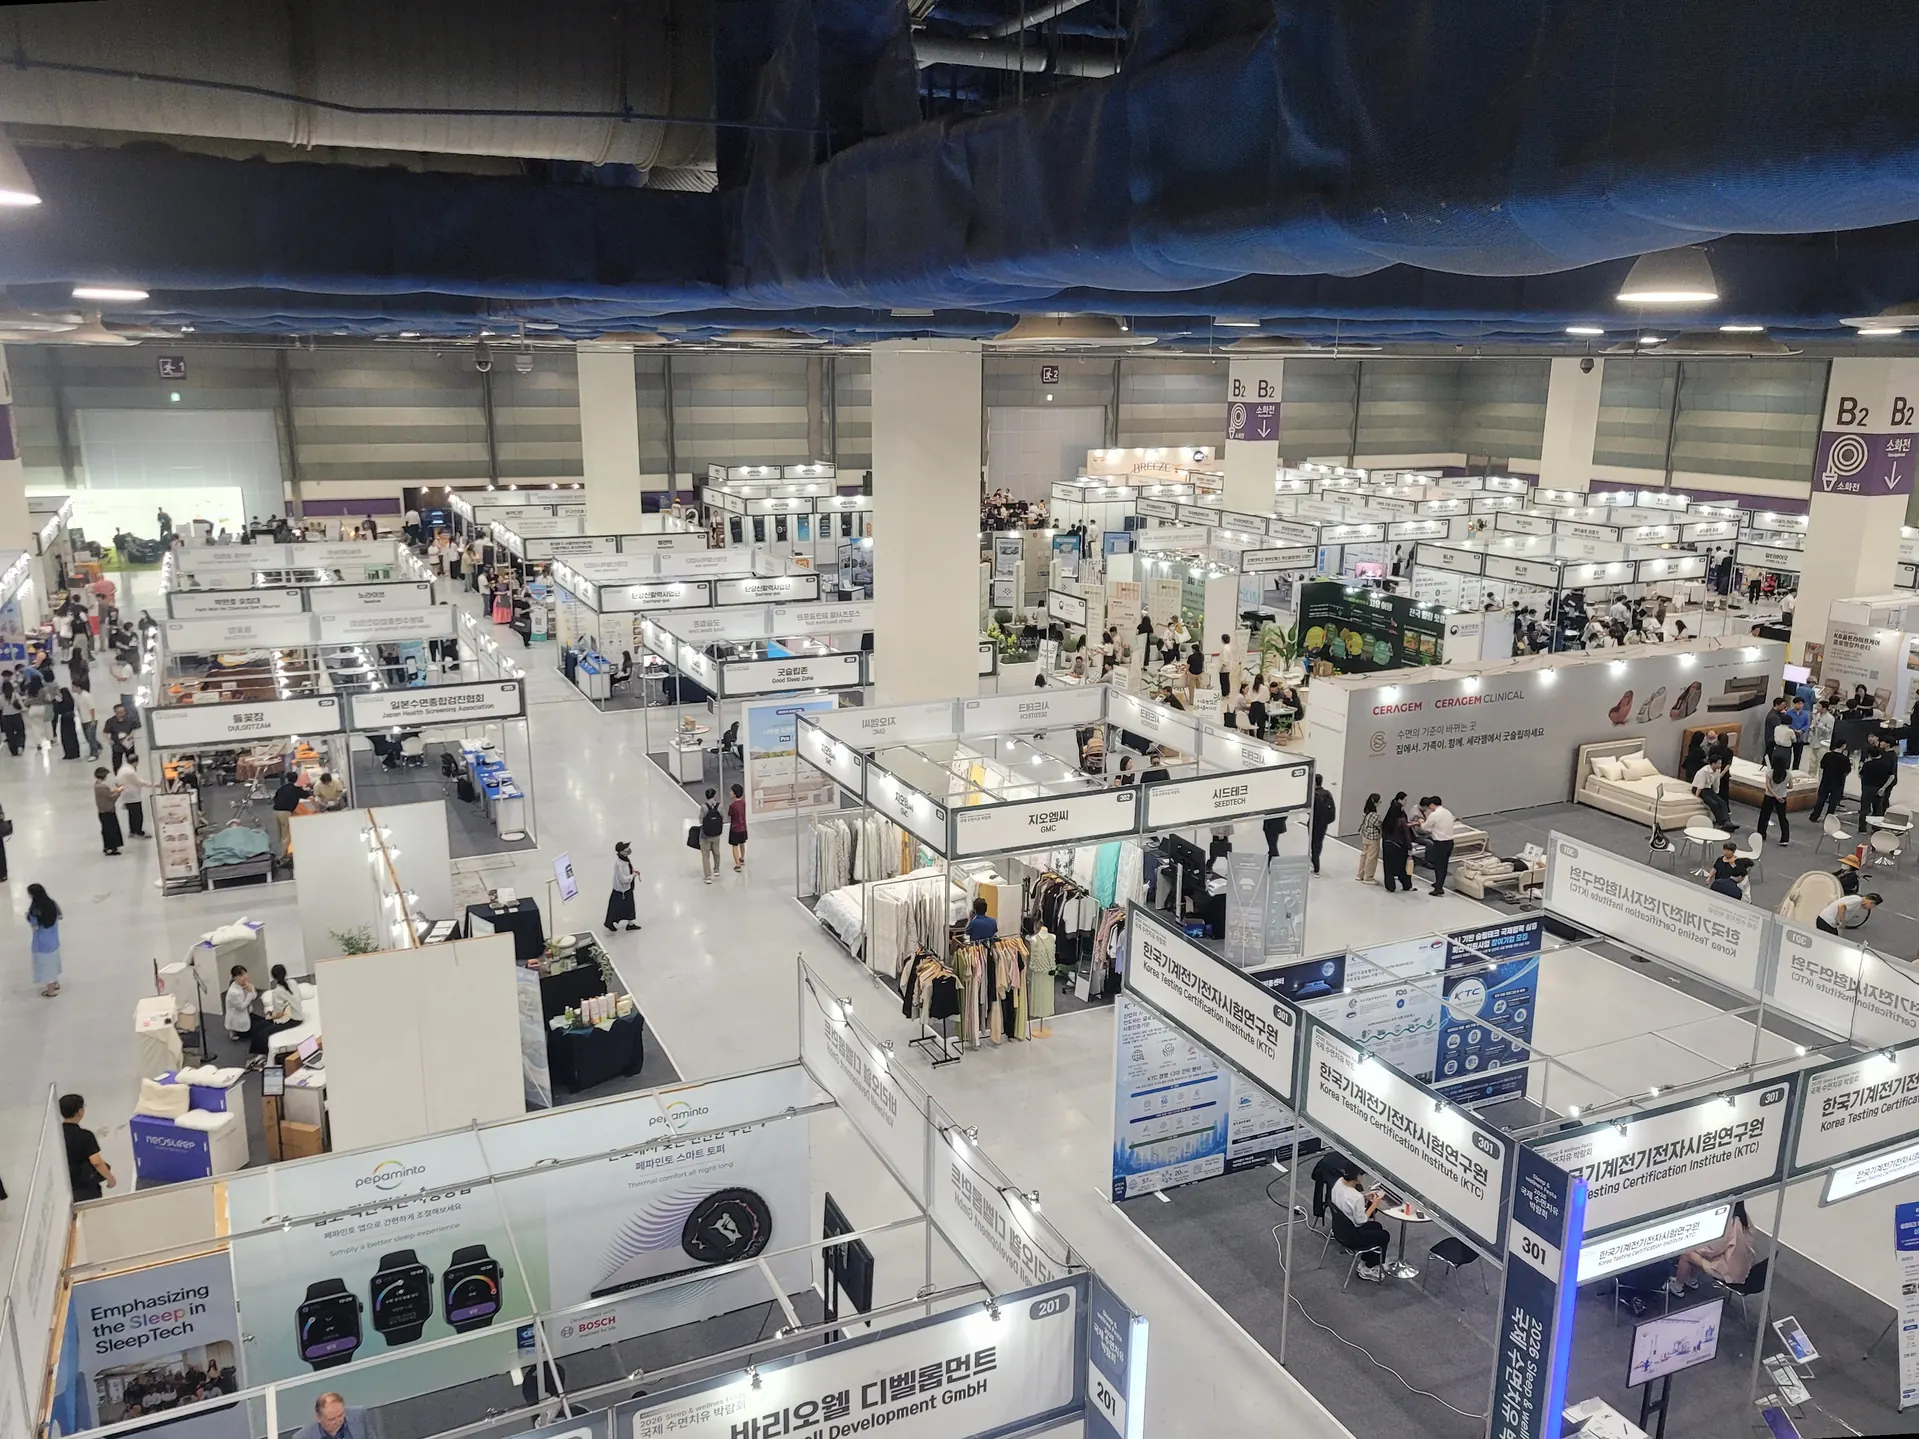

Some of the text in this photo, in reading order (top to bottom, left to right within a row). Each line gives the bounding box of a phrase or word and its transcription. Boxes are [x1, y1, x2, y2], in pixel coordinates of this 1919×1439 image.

[1233, 379, 1246, 397] B2
[1258, 380, 1275, 398] B2
[1837, 397, 1869, 426] B2
[1891, 397, 1914, 425] B2
[1885, 438, 1911, 451] 소화전
[1837, 482, 1860, 492] 소화전
[402, 708, 424, 716] Health
[426, 706, 457, 715] Screening
[458, 703, 495, 713] Association
[1373, 690, 1524, 716] CERAGEM CERAGEM CLINICAL
[1397, 721, 1477, 739] 수면의 기준이 바뀌는 곳
[1466, 727, 1545, 746] 세라젬에서 굿슬립하세요
[1120, 793, 1131, 801] 302
[1212, 784, 1249, 799] 시드테크
[1214, 797, 1247, 808] SEEDTECH
[1028, 810, 1069, 826] 지오엠씨
[1040, 825, 1057, 833] GMC
[1143, 941, 1279, 1047] 한국기계전기전자시험연구원
[1454, 987, 1481, 1001] KTC
[1143, 960, 1276, 1061] Korea Testing Certification Institute (KTC)
[1276, 1007, 1290, 1023] 301
[1764, 1091, 1779, 1104] 301
[1320, 1061, 1488, 1188] 한국기계전기전자시험연구원
[1820, 1117, 1845, 1133] Korea
[1848, 1107, 1879, 1125] Testing
[1319, 1081, 1485, 1201] Korea Testing Certification Institute (KTC)
[1477, 1136, 1495, 1156] 301
[635, 1143, 726, 1171] 페파인토 스마트 토퍼
[1586, 1140, 1760, 1201] esting Certification Institute (KTC)
[355, 1163, 427, 1189] pepaminto
[628, 1160, 734, 1189] Thermal comfort all night long
[1520, 1185, 1559, 1217] 국제 수면치유
[1529, 1200, 1548, 1220] 박람회
[367, 1237, 392, 1250] better
[394, 1232, 416, 1245] sleep
[417, 1222, 461, 1239] experience
[1521, 1236, 1546, 1266] 301
[1597, 1258, 1612, 1267] Korea
[1613, 1253, 1632, 1263] Testing
[1632, 1243, 1662, 1258] Certification
[90, 1285, 210, 1322] Emphasizing
[1038, 1300, 1061, 1316] 201
[92, 1302, 206, 1339] the Sleep in
[578, 1315, 616, 1333] BOSCH
[1510, 1306, 1530, 1351] 국제
[95, 1321, 195, 1356] SleepTech
[1523, 1317, 1543, 1410] 2026 Sleep &
[730, 1345, 998, 1439] 바리오웰 디벨롭먼트
[1096, 1381, 1116, 1417] 201
[1501, 1347, 1525, 1427] 수면치유
[639, 1417, 663, 1428] 2026
[665, 1410, 688, 1423] Sleep
[694, 1400, 724, 1413] wellnes
[639, 1399, 747, 1439] 국제 수면치유 박람회
[828, 1378, 988, 1439] Development GmbH
